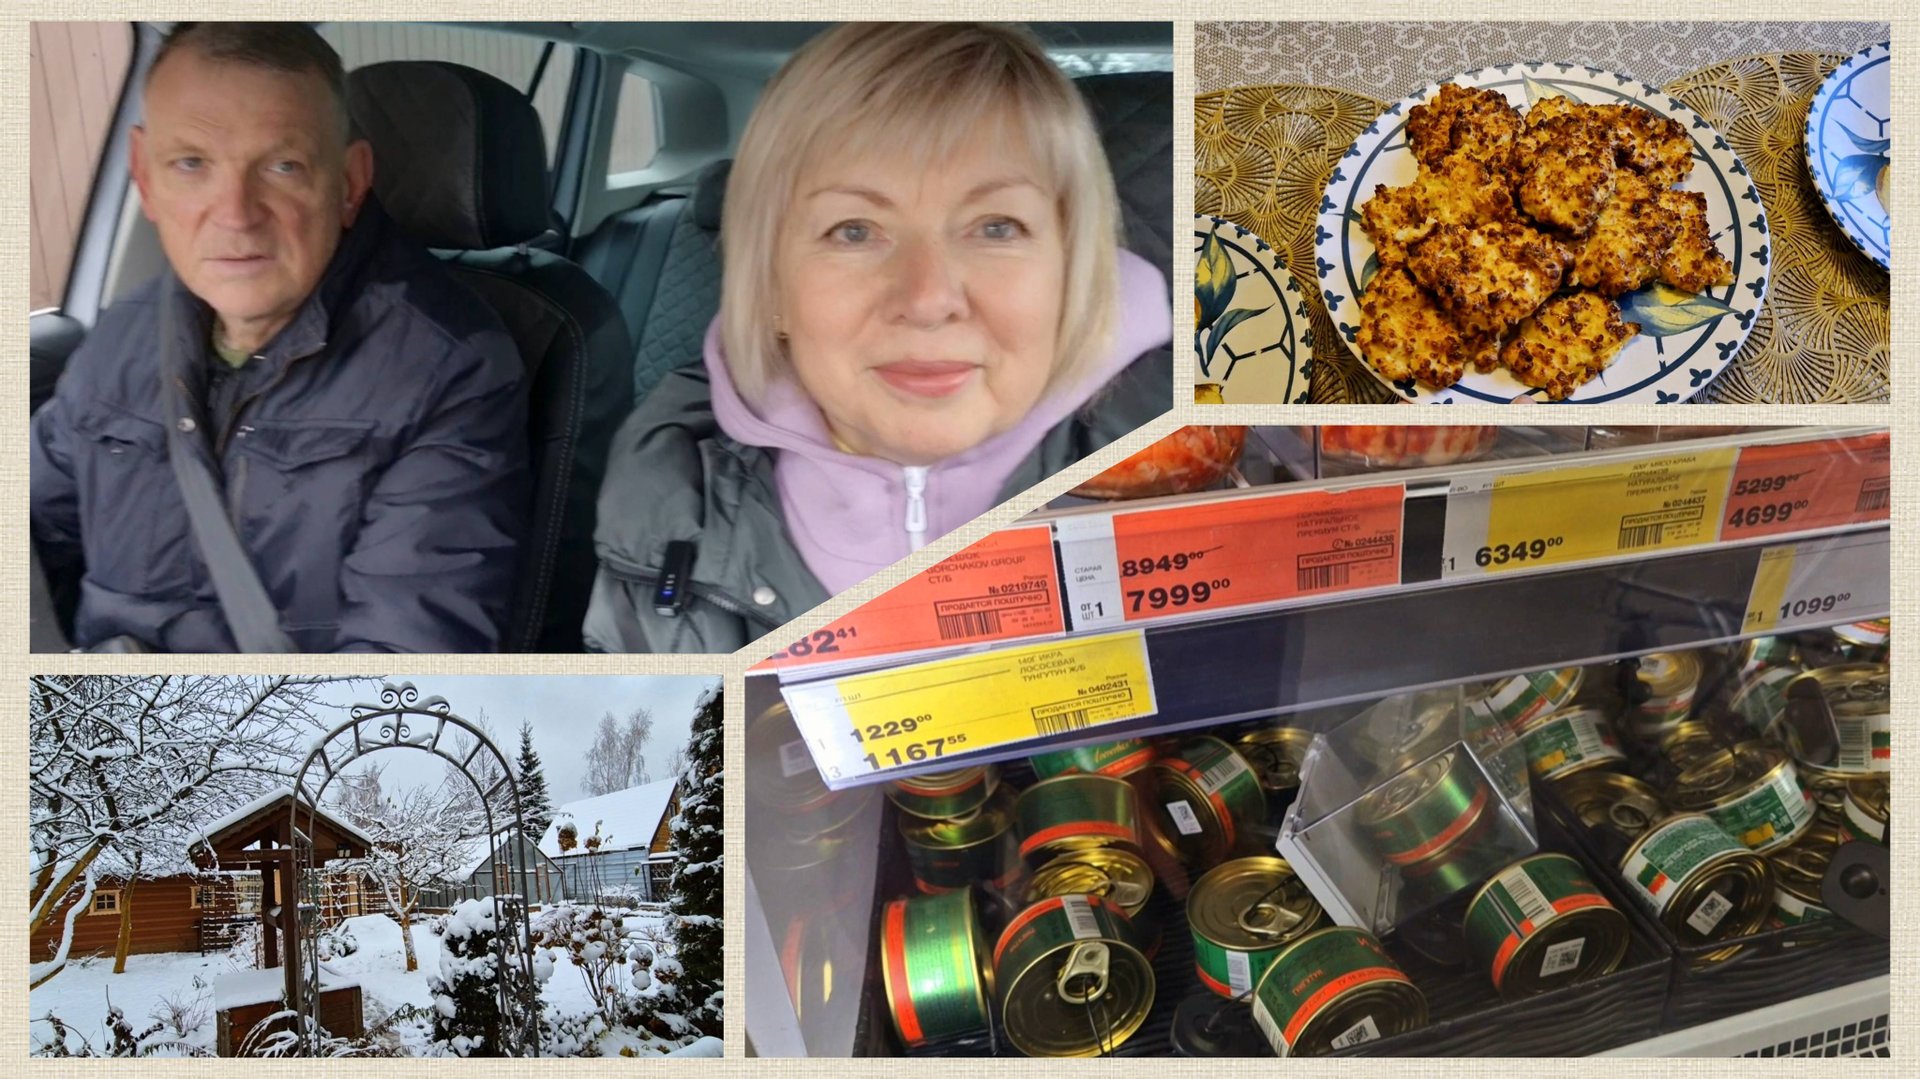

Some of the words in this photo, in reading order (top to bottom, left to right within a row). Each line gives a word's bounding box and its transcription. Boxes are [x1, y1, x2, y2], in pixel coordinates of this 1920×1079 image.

[1000, 580, 1047, 594] 0219749
[940, 600, 993, 613] ПРОДАЕТСЯ
[1095, 601, 1104, 617] 1
[1039, 651, 1063, 661] ИКРА
[1020, 657, 1075, 674] ЛОСОСЕВАЯ
[1022, 668, 1067, 683] ТУНГУТУН
[1088, 679, 1129, 695] 0402431
